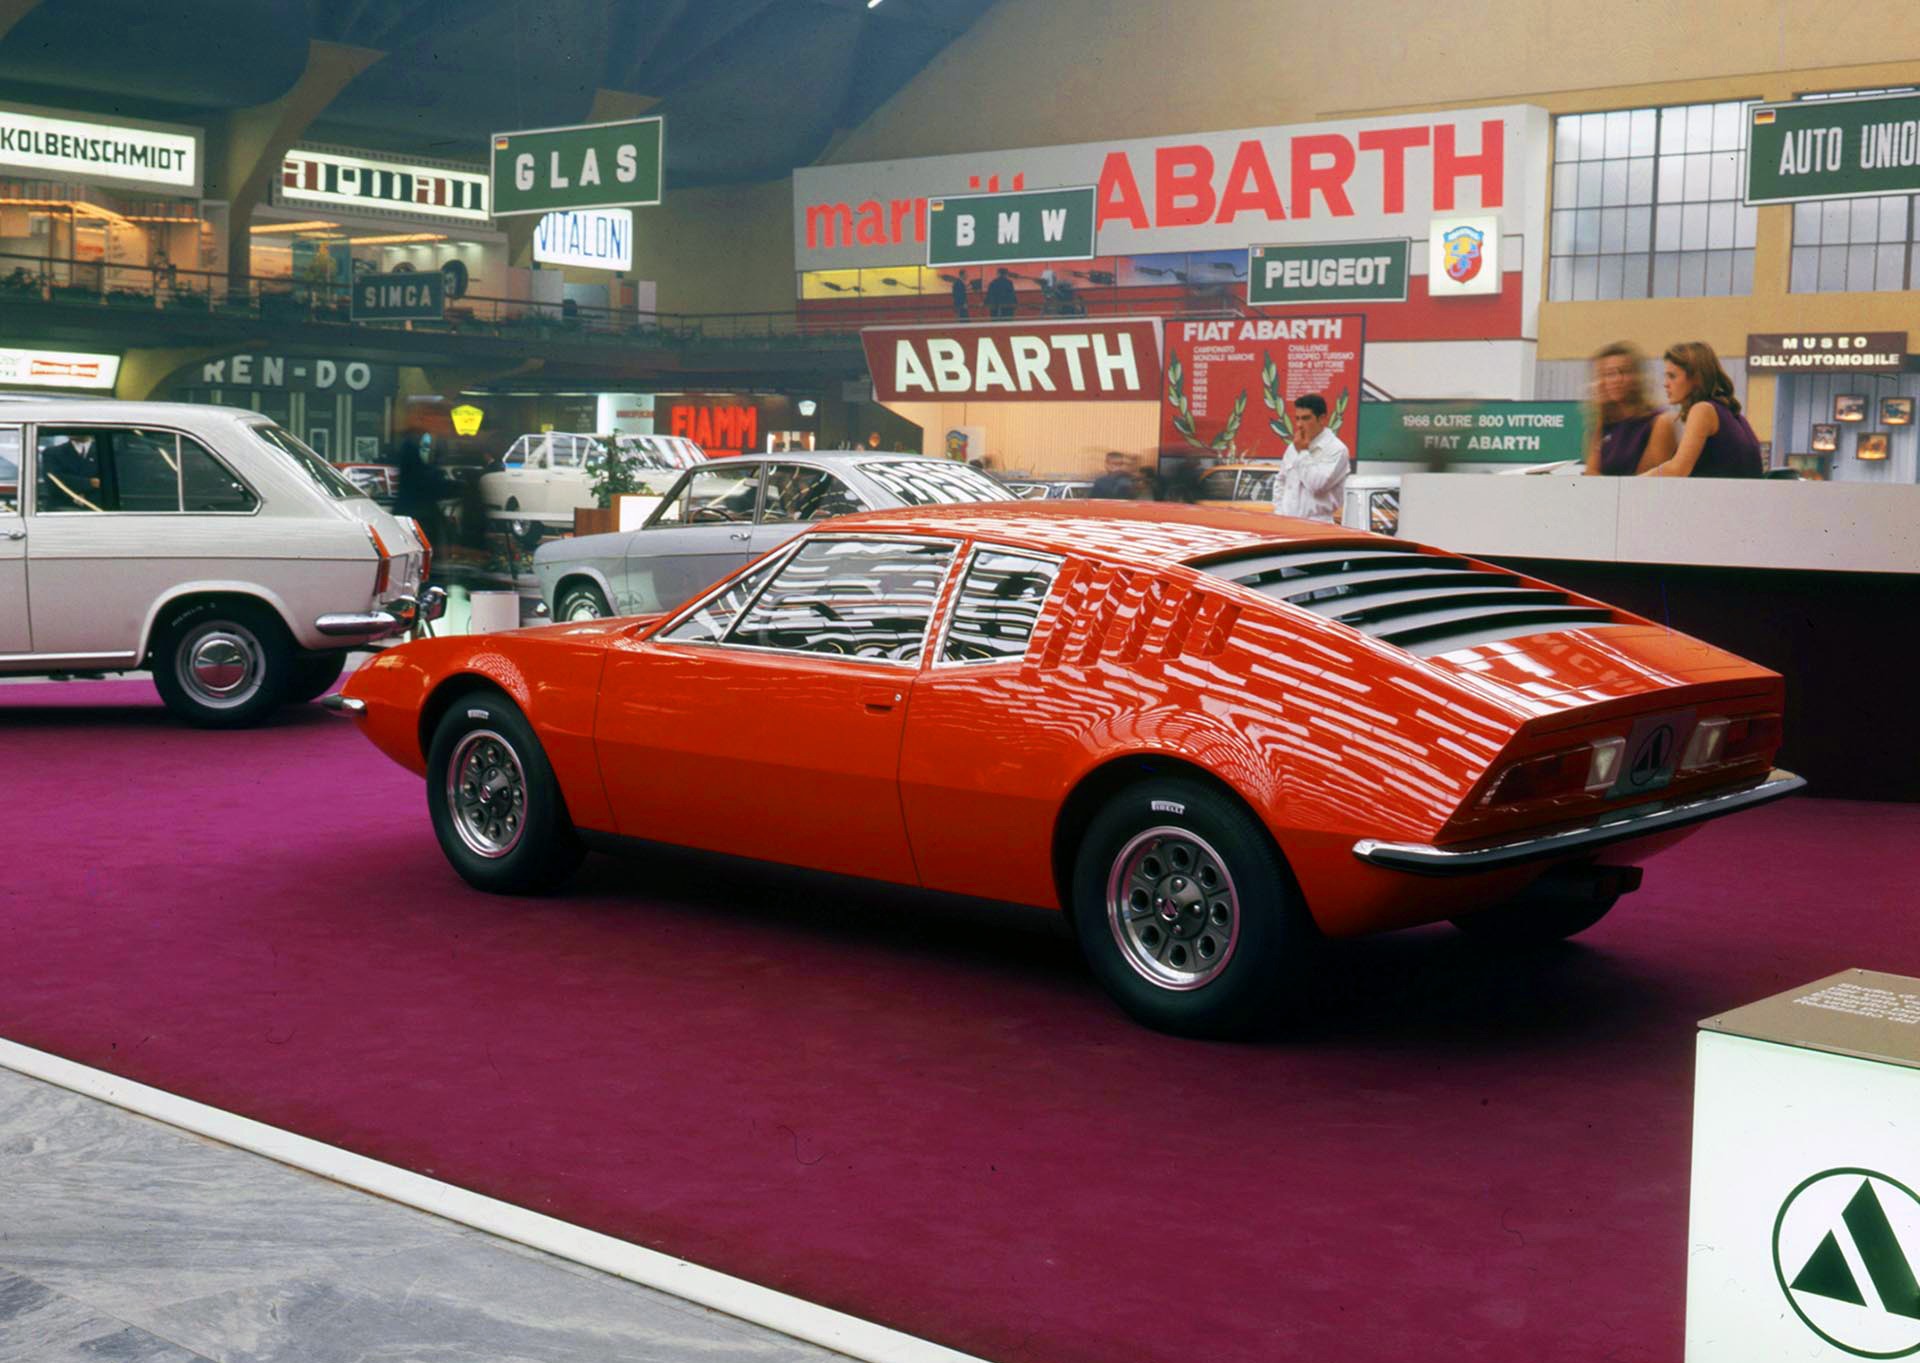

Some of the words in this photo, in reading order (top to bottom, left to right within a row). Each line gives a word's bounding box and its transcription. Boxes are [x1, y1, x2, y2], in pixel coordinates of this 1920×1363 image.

[0, 127, 186, 171] KOLBENSCHMIDT
[1779, 127, 1843, 175] AUTO
[1860, 120, 1920, 169] UNIO
[515, 144, 638, 191] GLAS
[1096, 119, 1504, 231] ABARTH
[535, 211, 628, 260] VITALONI
[956, 208, 1067, 247] BMW
[1265, 256, 1391, 289] PEUGEOT
[365, 284, 432, 308] SIMCA
[1183, 321, 1235, 342] FIAT
[1238, 318, 1343, 341] ABARTH
[1782, 336, 1868, 349] MUSEO
[895, 332, 1141, 393] ABARTH
[1750, 353, 1900, 367] DELL'AUTOMOBILE
[671, 406, 757, 449] FIAMM
[1403, 415, 1430, 427] 1968
[1434, 415, 1472, 427] OLTRE
[1478, 415, 1504, 427] 800
[1507, 415, 1564, 427] VITTORIE
[1424, 436, 1460, 449] FIAT
[1467, 436, 1540, 450] ABARTH
